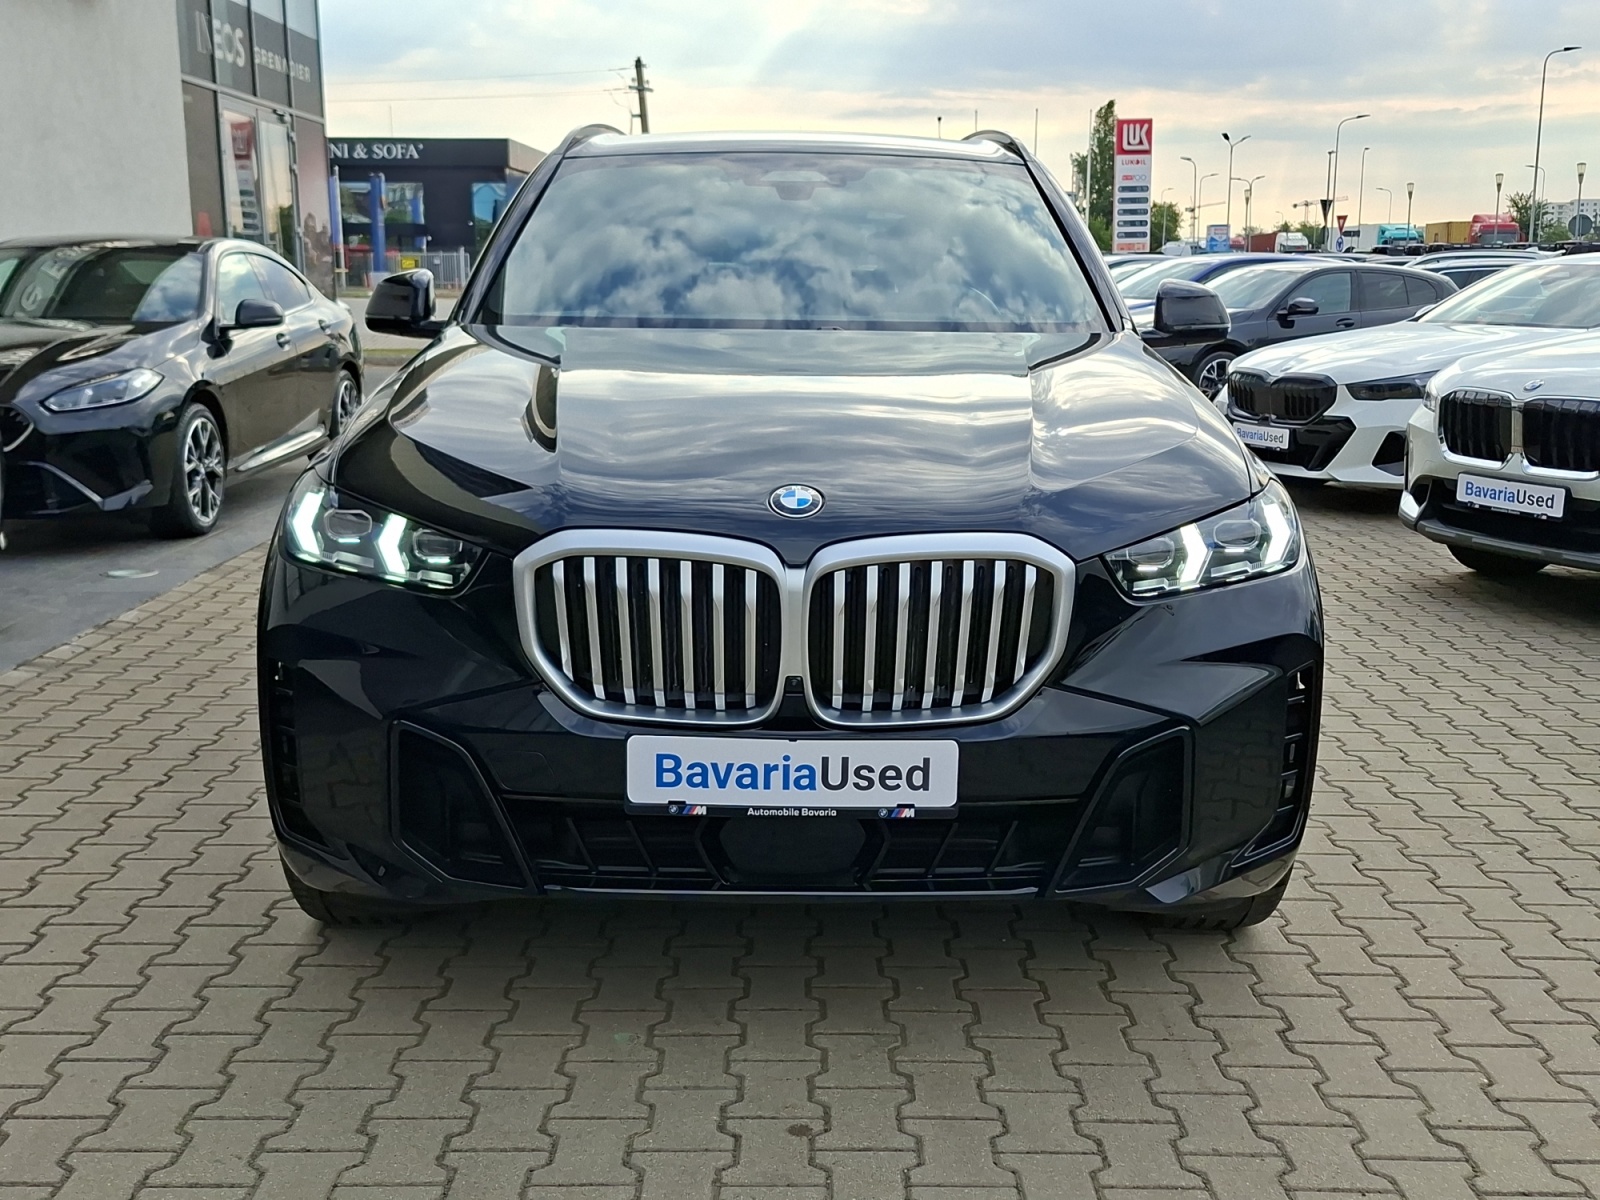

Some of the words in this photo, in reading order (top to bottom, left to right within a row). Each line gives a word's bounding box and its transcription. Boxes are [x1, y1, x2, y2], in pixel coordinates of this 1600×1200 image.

[196, 10, 245, 67] INEOS
[352, 143, 369, 159] &
[1236, 427, 1285, 444] BavariaUsed
[1465, 481, 1556, 510] BavariaUsed
[655, 753, 931, 792] BavariaUsed
[747, 807, 800, 817] Automobile
[801, 808, 837, 817] Bavaria
